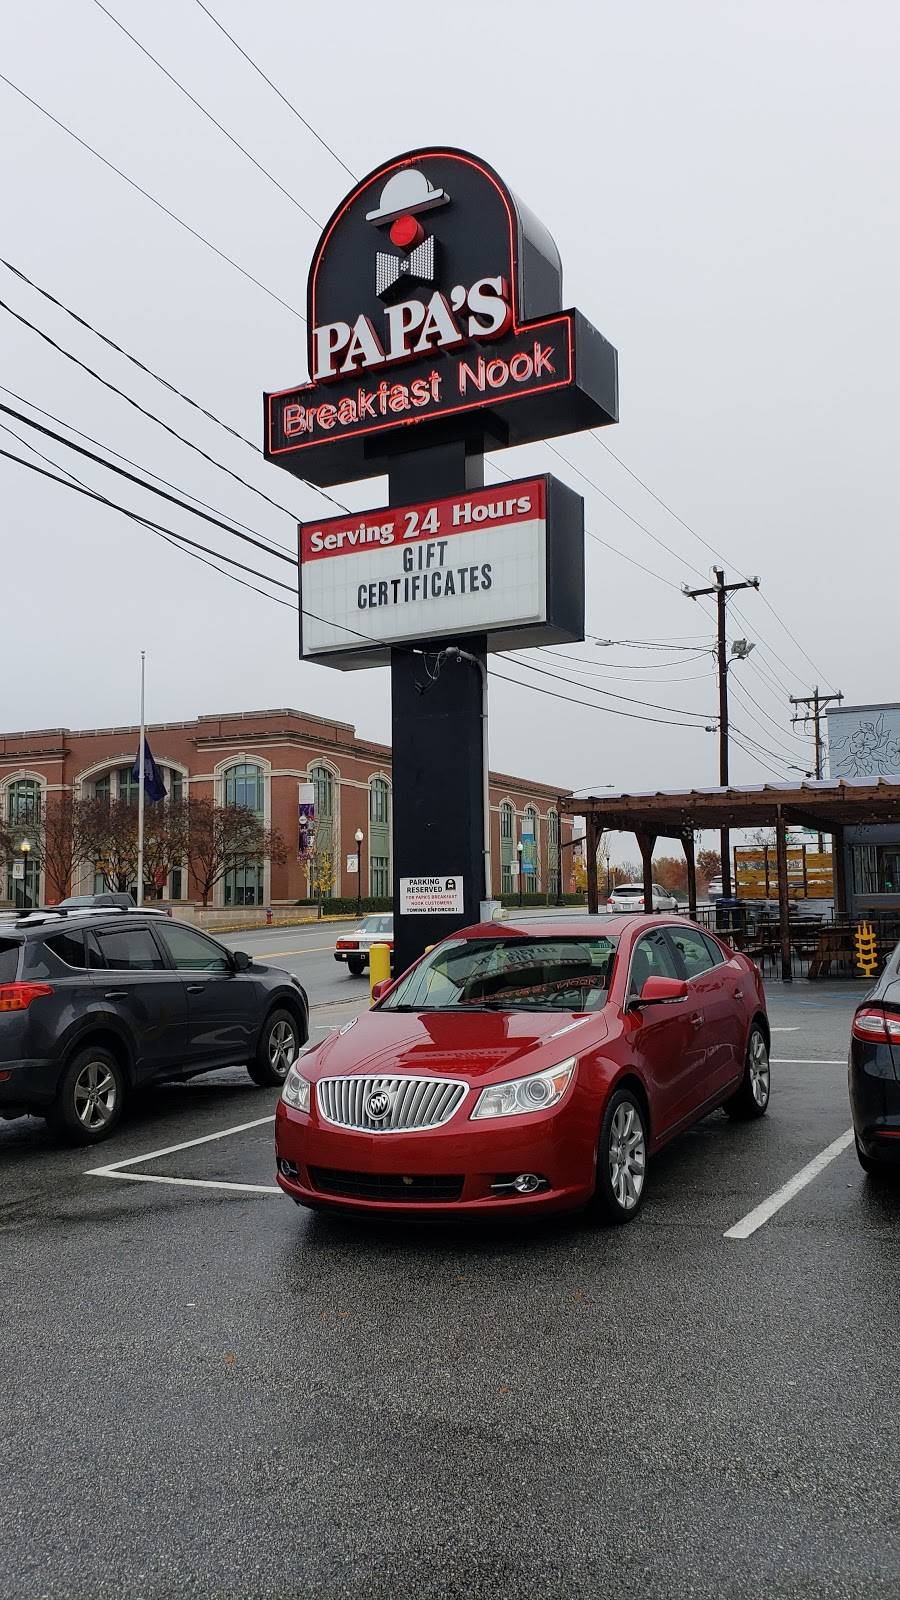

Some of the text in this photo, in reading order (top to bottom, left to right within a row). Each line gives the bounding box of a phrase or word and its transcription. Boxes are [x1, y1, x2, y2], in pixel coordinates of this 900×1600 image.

[312, 276, 509, 380] PAPA'S
[283, 341, 557, 438] Breakfast Nook
[310, 495, 532, 553] Serving 24 Hours
[403, 541, 448, 572] GIFT
[357, 563, 492, 610] CERTIFICATES
